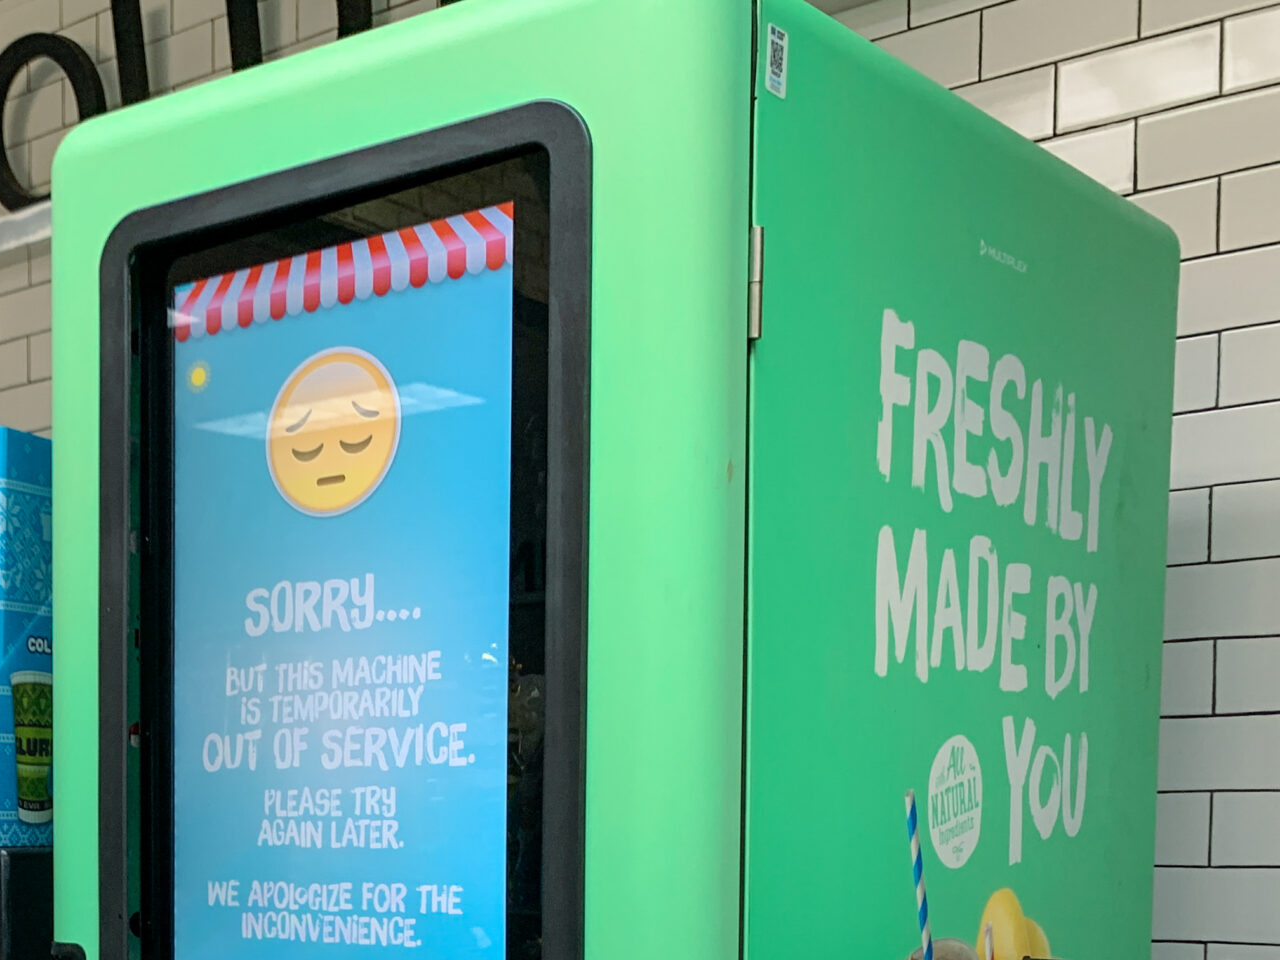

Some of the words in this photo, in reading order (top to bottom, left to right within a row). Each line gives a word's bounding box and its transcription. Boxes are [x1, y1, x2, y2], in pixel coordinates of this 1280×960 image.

[876, 308, 1113, 553] FRESHLY
[874, 525, 1032, 692] MADE
[1044, 574, 1098, 700] BY
[225, 664, 268, 697] BUT
[275, 661, 324, 694] THIS
[331, 650, 442, 689] MACHINE
[240, 697, 261, 725] IS
[269, 685, 425, 724] TEMPORARILY
[202, 729, 262, 773] OUT
[273, 727, 309, 770] OF
[320, 722, 476, 772] SERVICE.
[264, 787, 343, 818] PLEASE
[351, 785, 396, 818] TRY
[931, 776, 979, 829] NATURAL
[1001, 715, 1089, 866] YOU
[257, 819, 322, 849] AGAIN
[330, 818, 405, 850] LATER.
[207, 880, 240, 908] WE
[248, 880, 353, 912] APOLOGIZE
[361, 882, 408, 915] FOR
[416, 884, 464, 916] THE
[241, 911, 422, 948] INCONVENIENCE.
